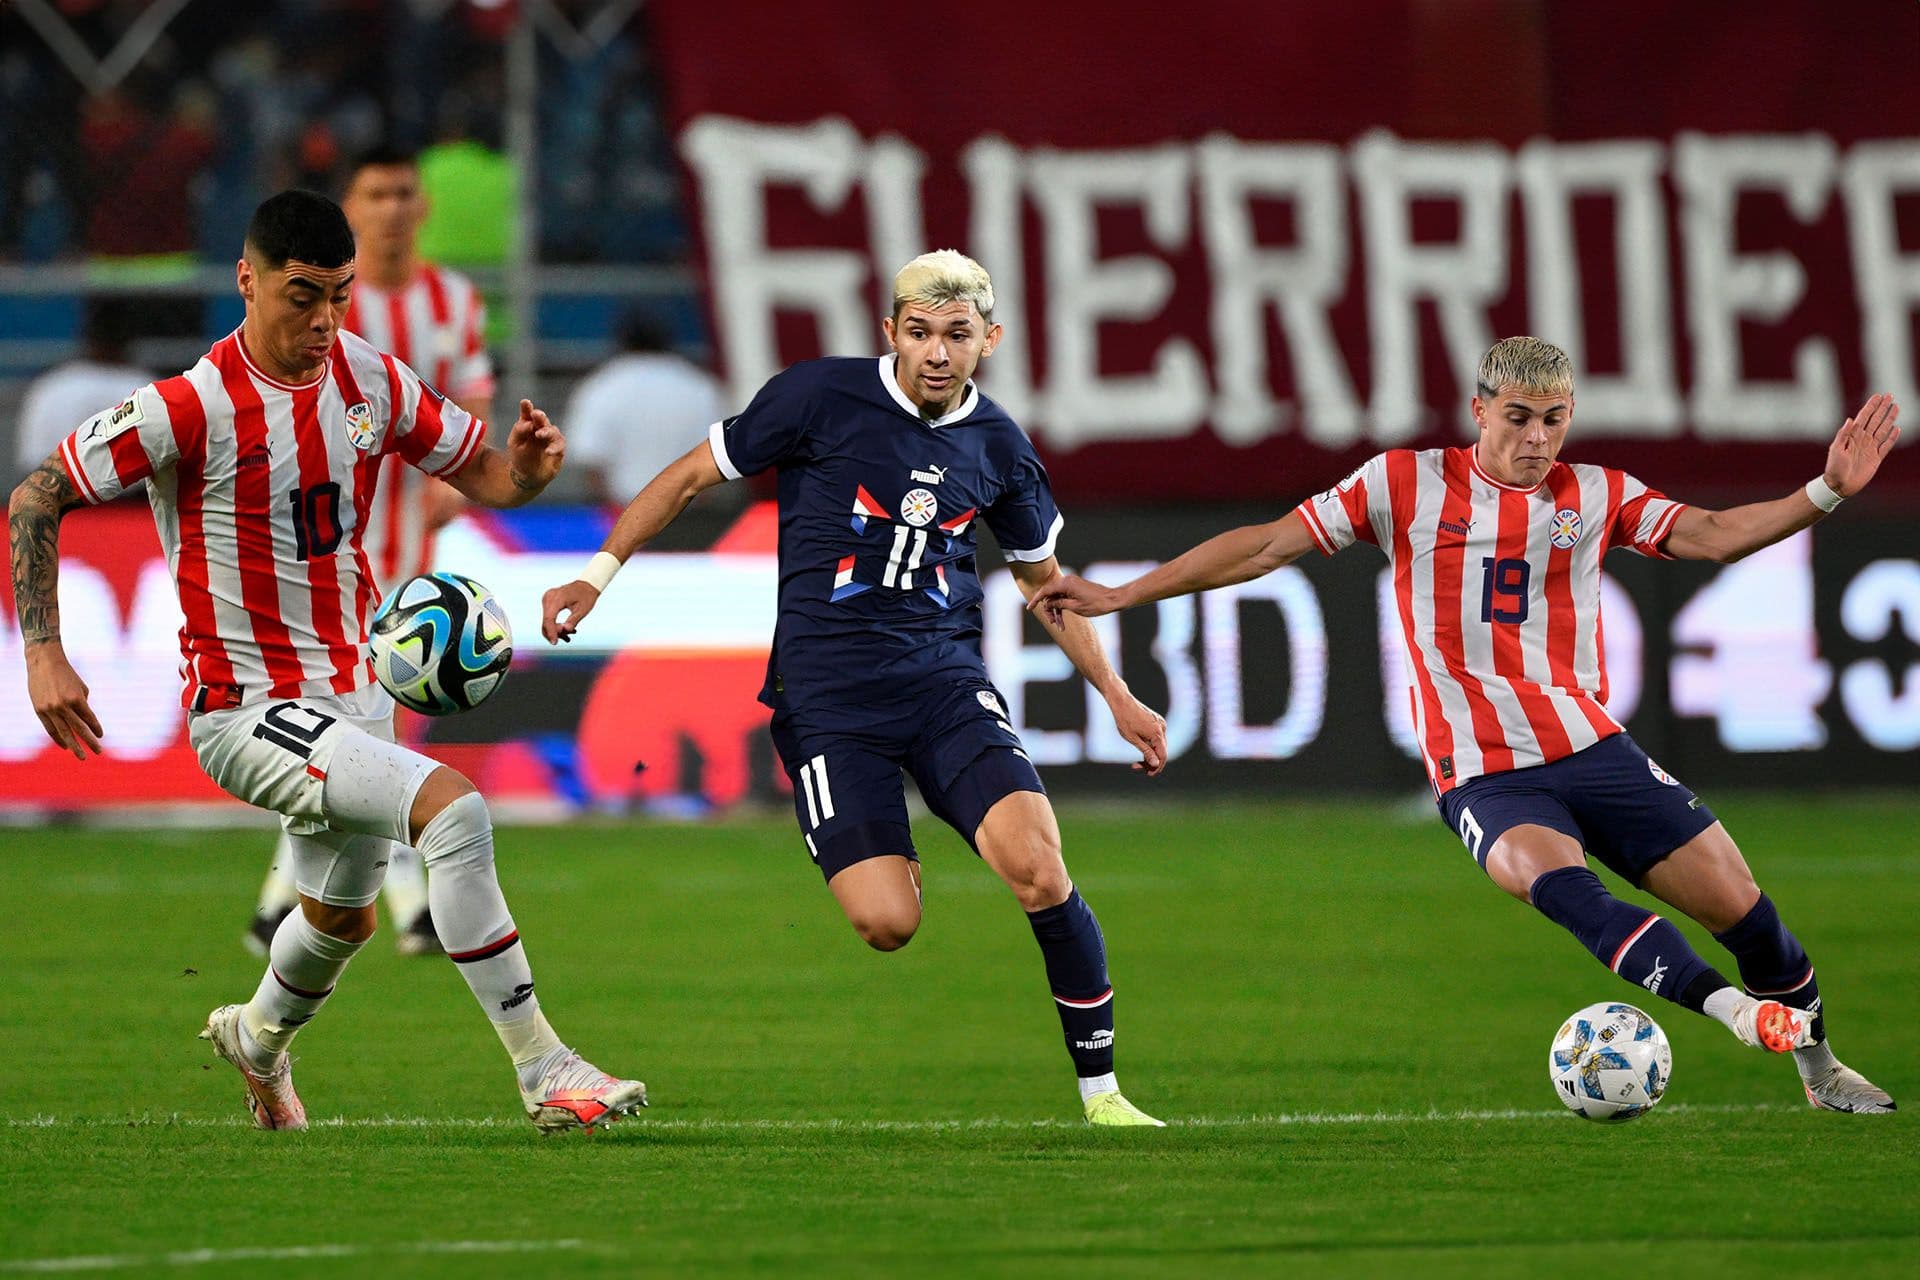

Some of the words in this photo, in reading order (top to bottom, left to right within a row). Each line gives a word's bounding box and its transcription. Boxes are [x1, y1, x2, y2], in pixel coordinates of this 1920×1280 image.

[290, 482, 343, 561] 10
[882, 525, 928, 590] 11
[1481, 557, 1531, 624] 19
[252, 701, 337, 760] 10
[800, 754, 835, 830] 11
[1076, 1036, 1113, 1050] PUMA
